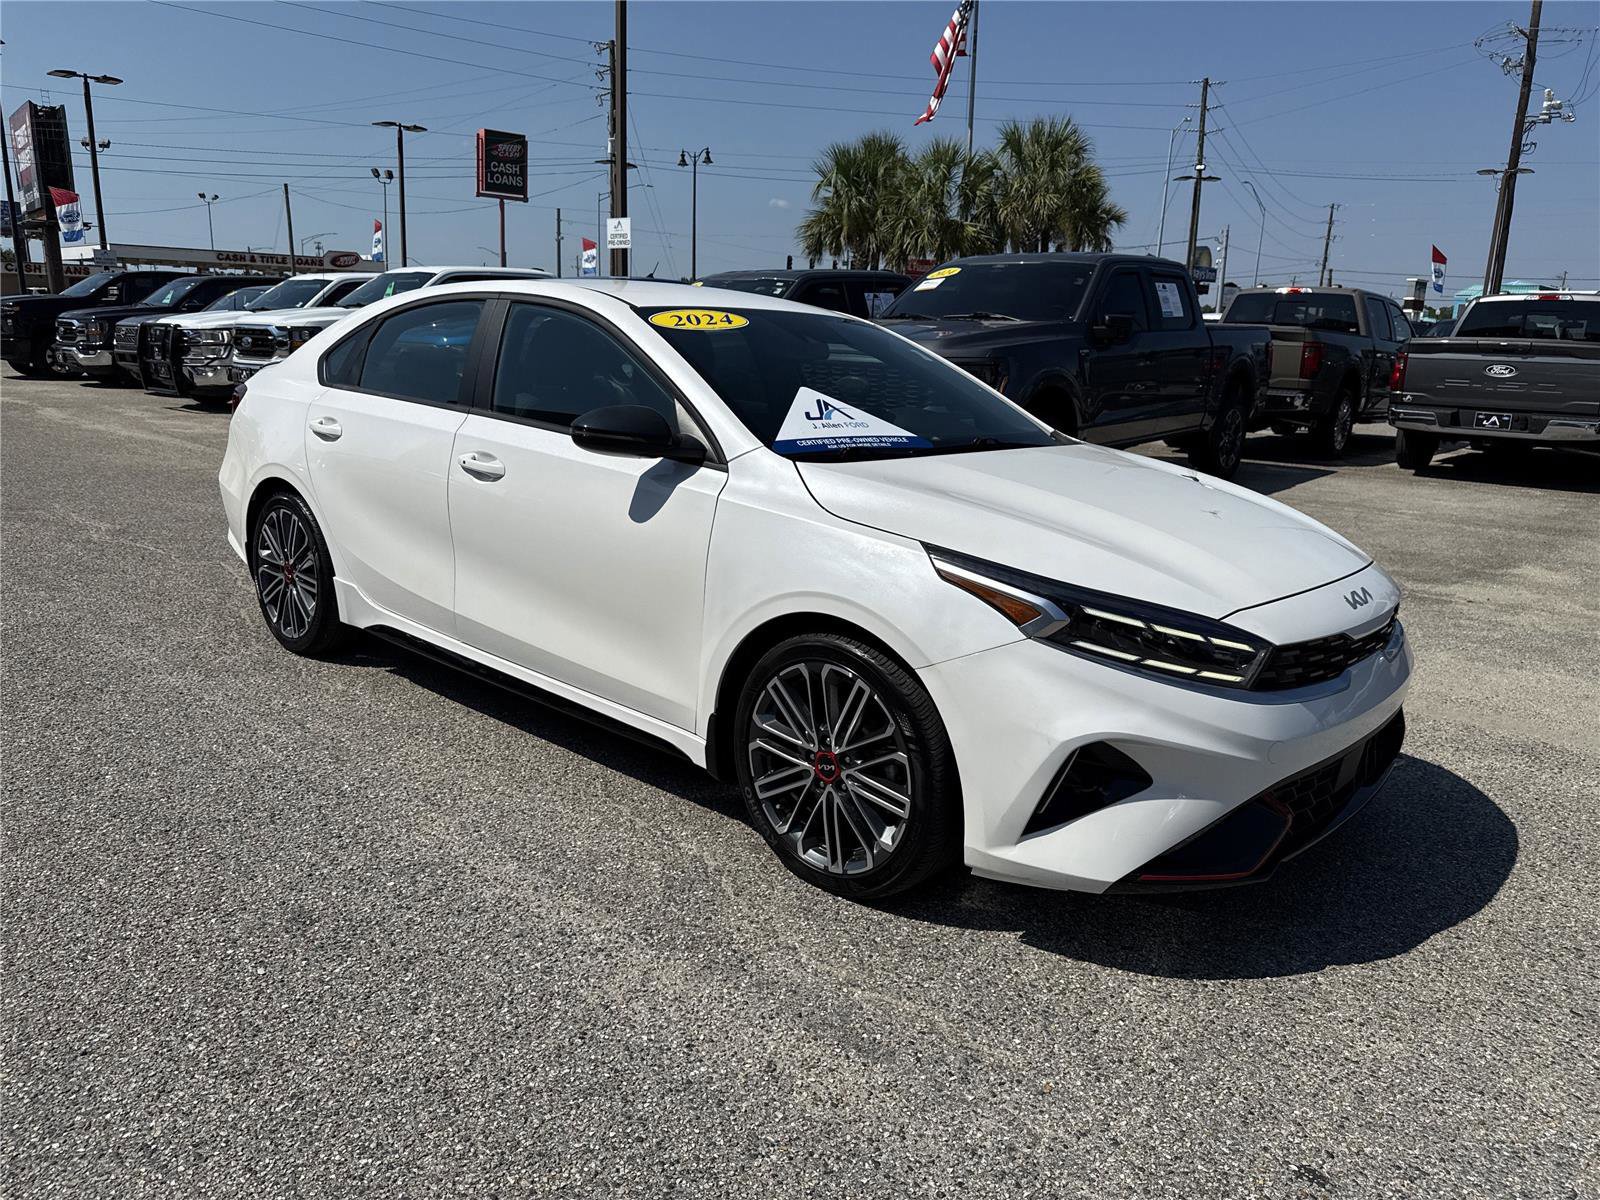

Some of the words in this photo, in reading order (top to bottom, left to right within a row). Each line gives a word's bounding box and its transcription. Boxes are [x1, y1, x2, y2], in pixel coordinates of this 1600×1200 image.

[490, 161, 520, 175] CASH
[487, 172, 524, 187] LOANS
[216, 252, 246, 263] CASH
[260, 255, 288, 265] TITLE
[293, 257, 324, 267] OANS
[4, 262, 42, 274] CSH
[669, 313, 734, 327] 2024
[804, 398, 855, 421] JA
[822, 421, 844, 430] Allen
[845, 421, 870, 429] FORD
[796, 438, 836, 446] CERTIFIED
[880, 436, 910, 444] VEHICLE
